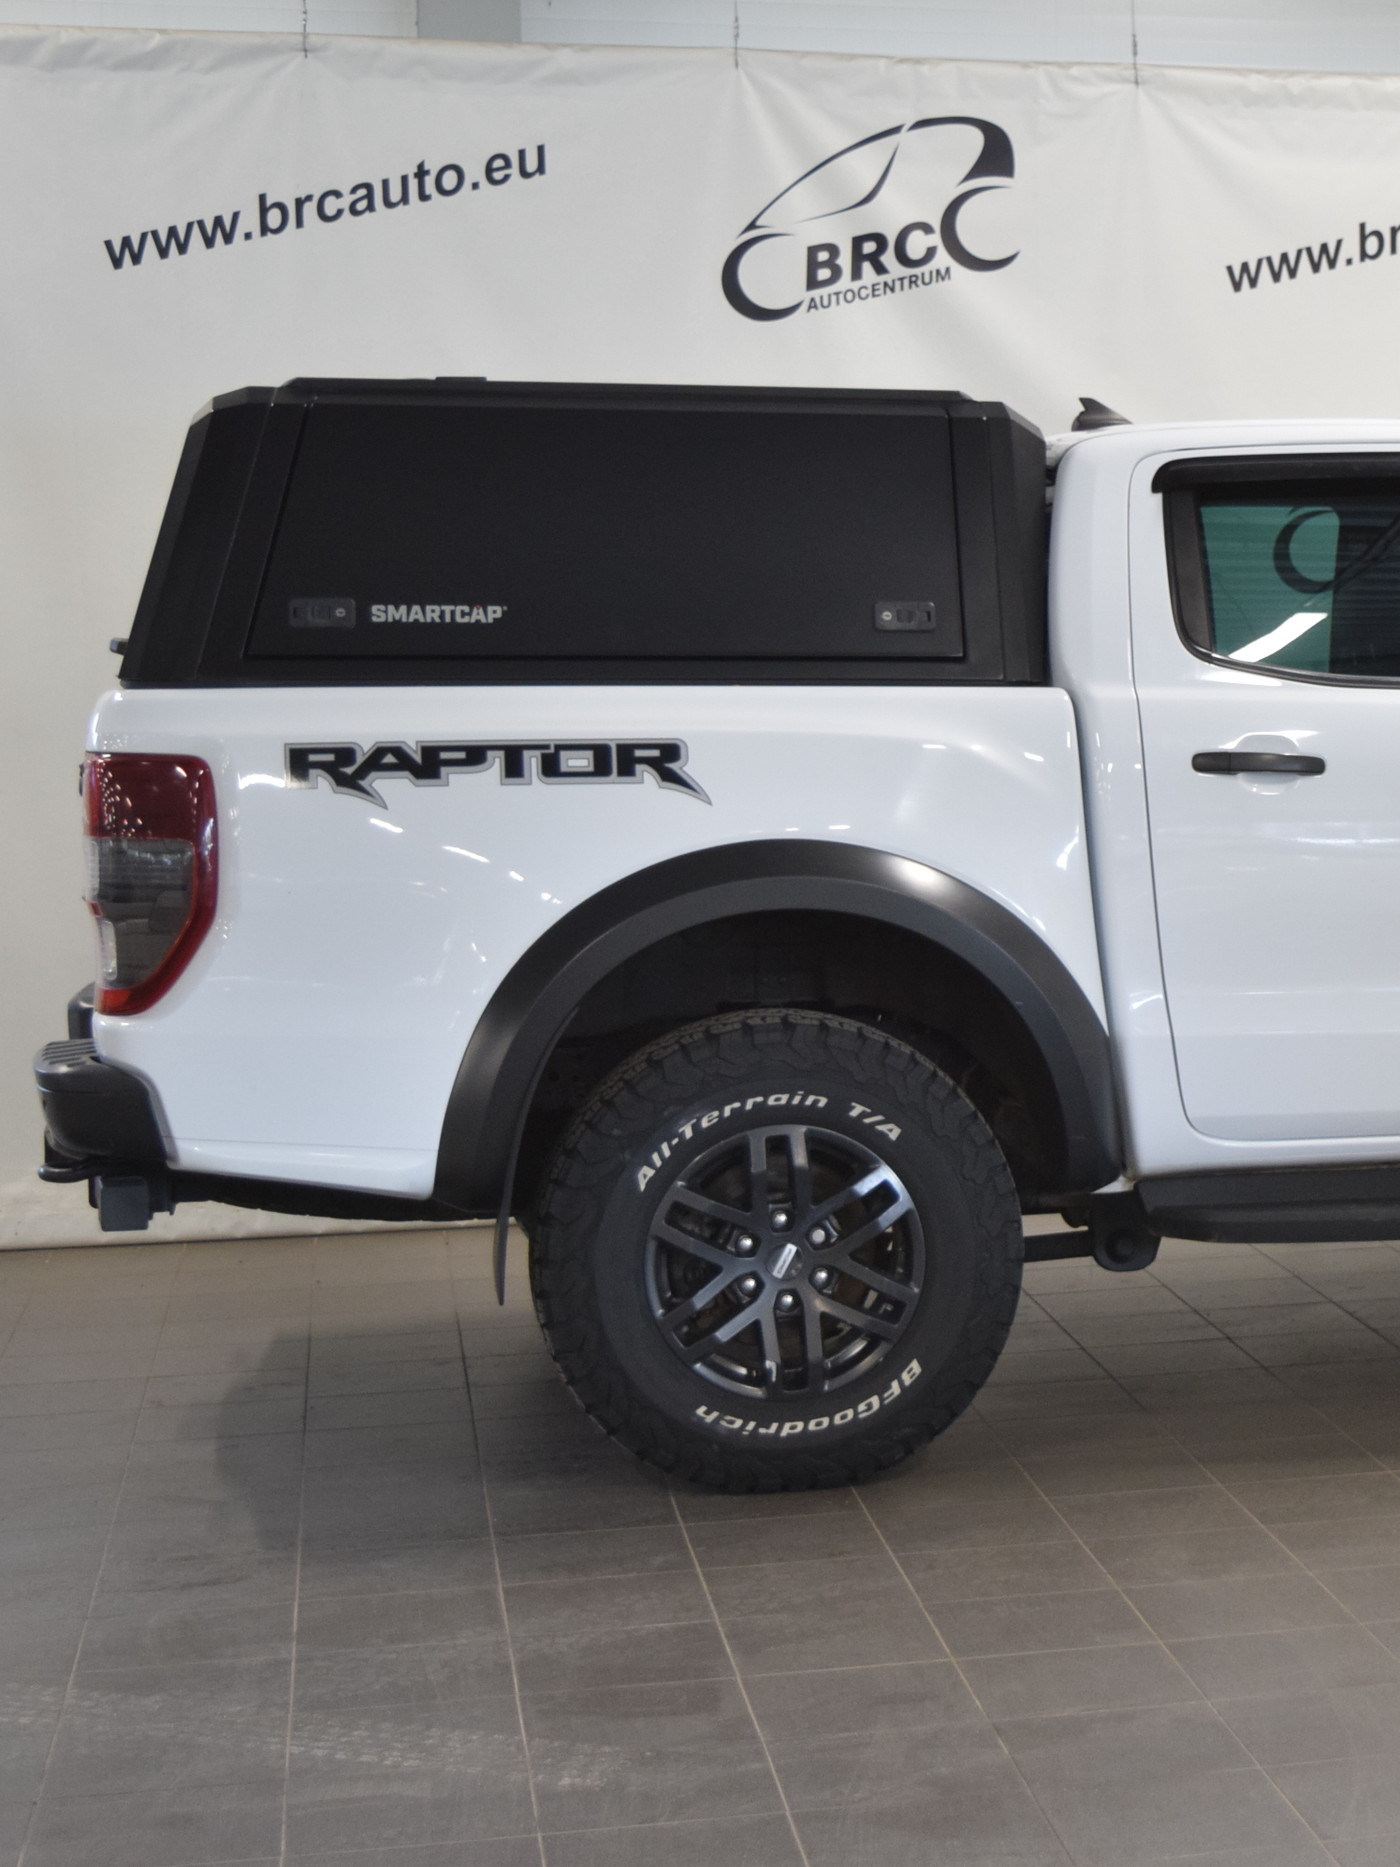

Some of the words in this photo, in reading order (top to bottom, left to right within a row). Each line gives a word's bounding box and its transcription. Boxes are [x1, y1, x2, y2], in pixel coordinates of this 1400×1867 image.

[103, 144, 546, 271] www.brcauto.eu
[806, 221, 937, 291] BRC
[807, 267, 951, 313] AUTOCENTRUM
[371, 604, 503, 624] SMARTCAP
[285, 738, 712, 809] RAPTOR
[637, 1091, 828, 1192] All-Terrain
[848, 1101, 902, 1142] T/A
[696, 1358, 922, 1437] BFGoodrich
